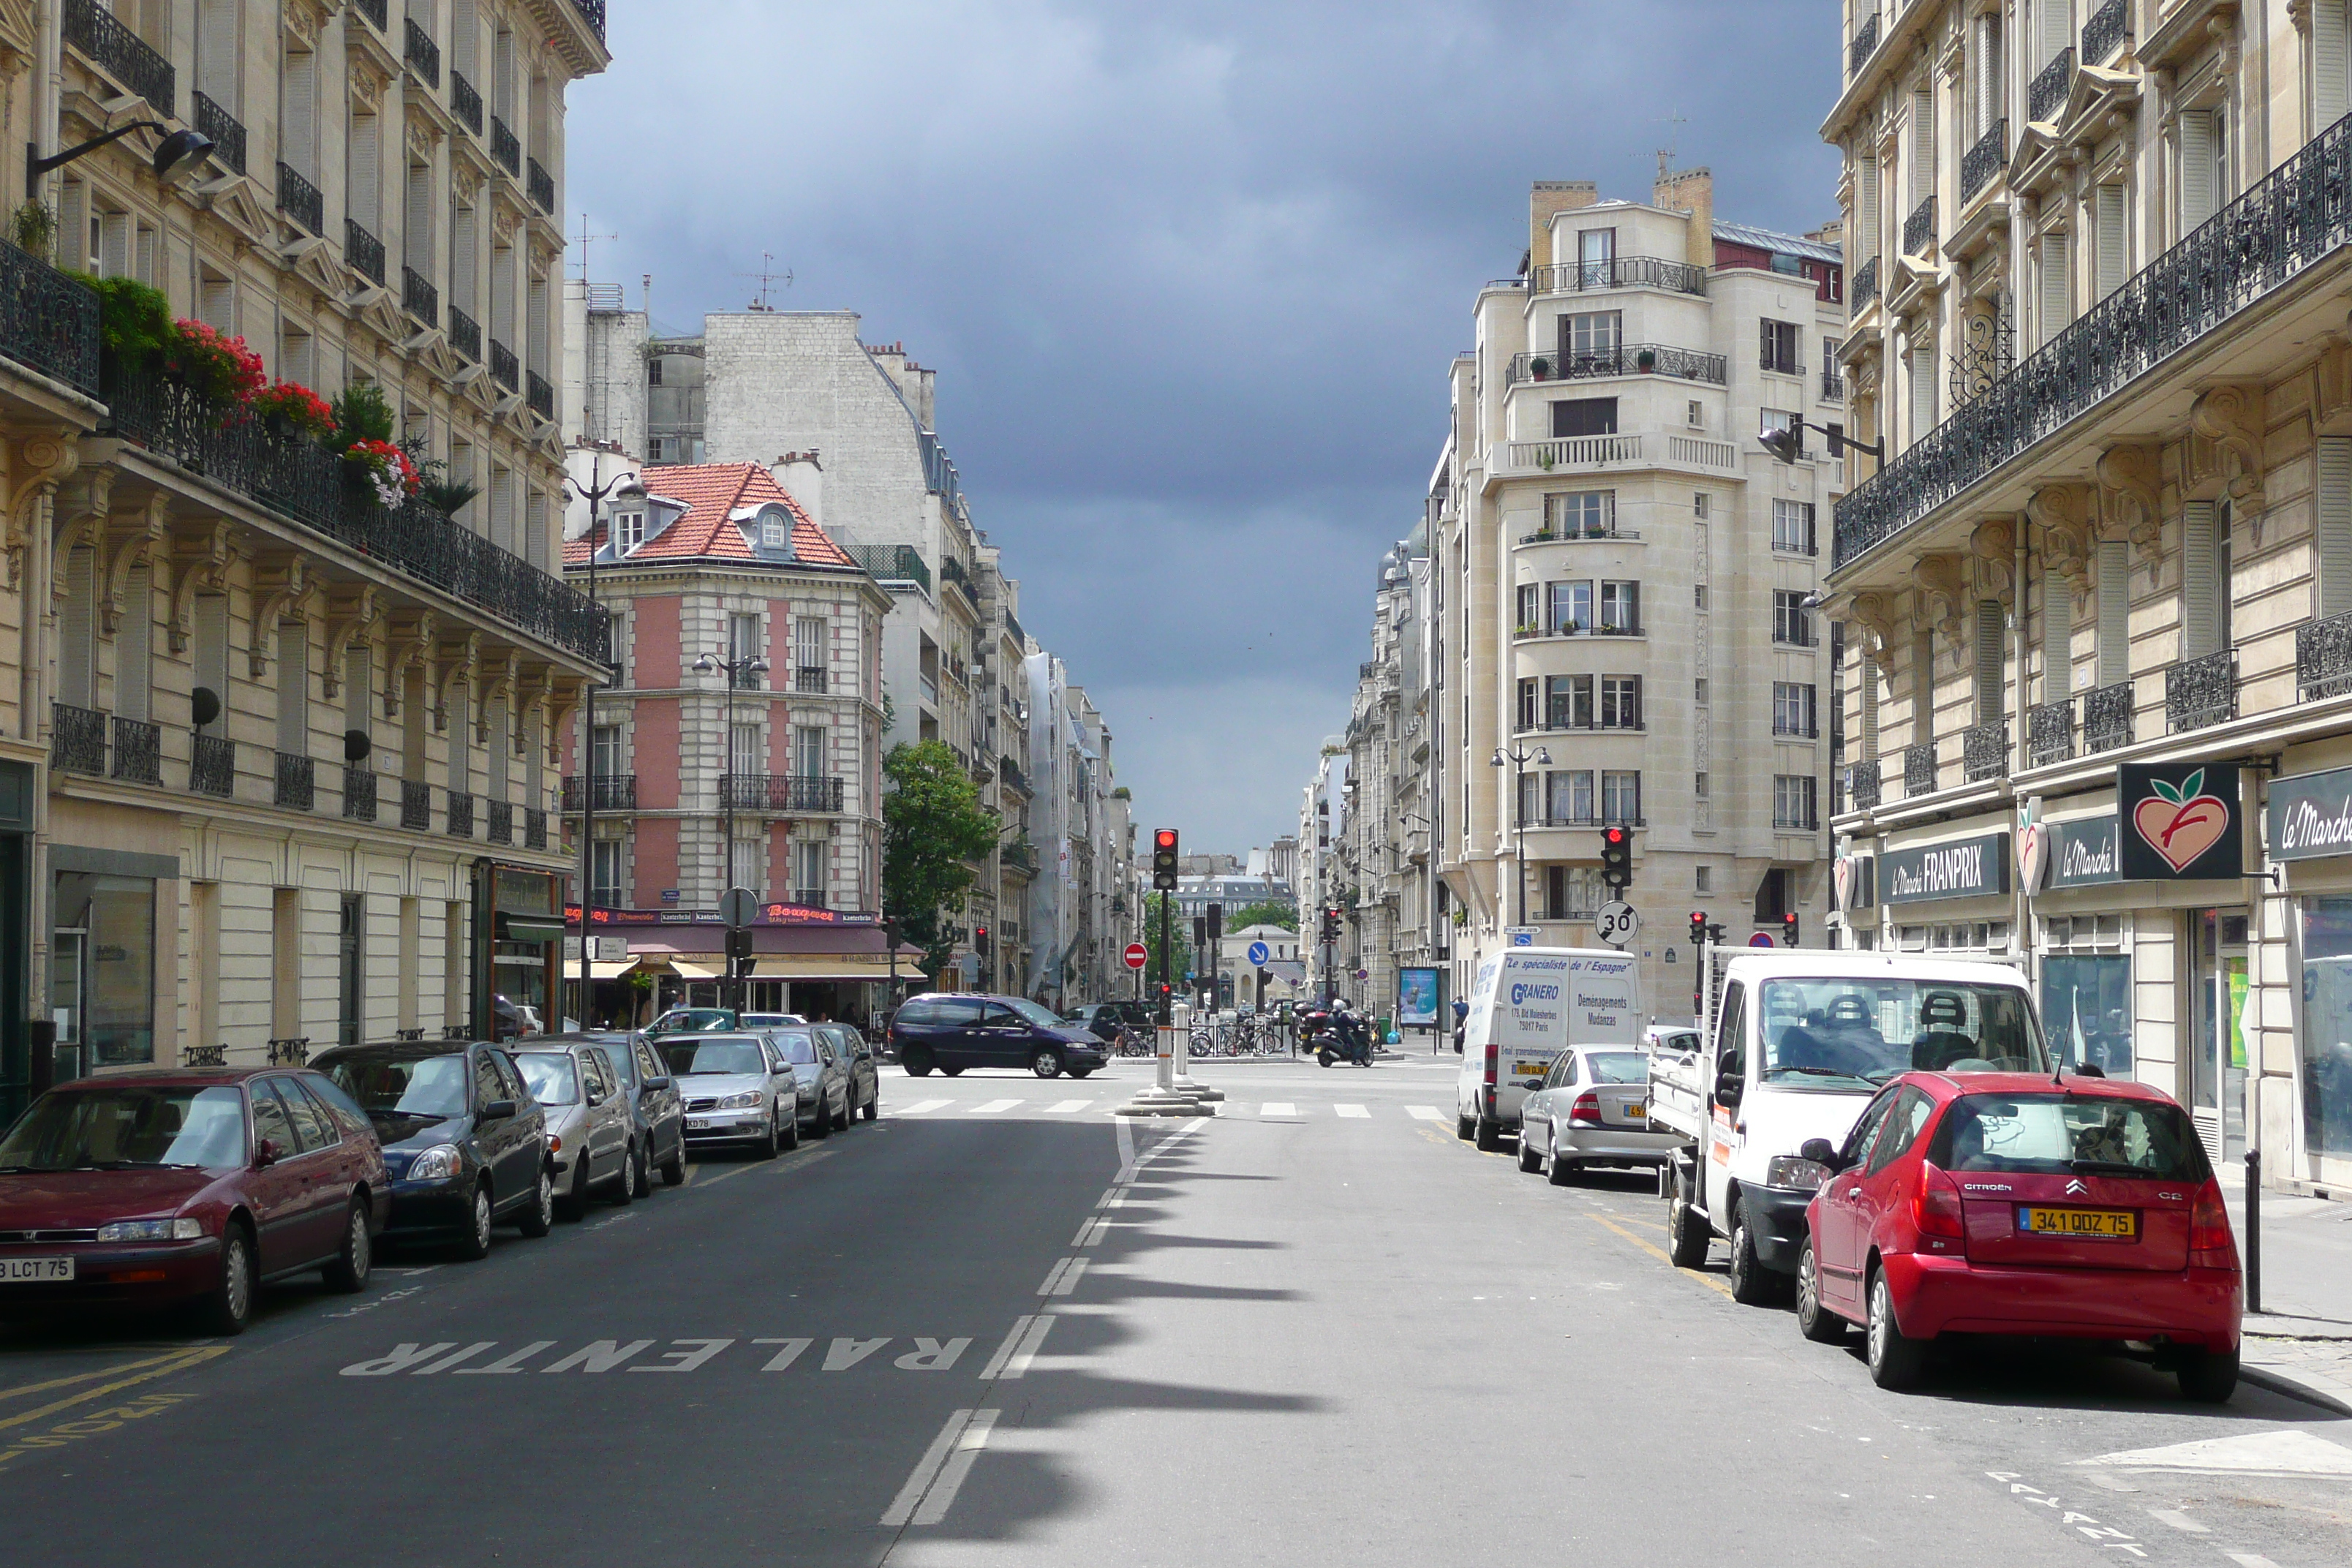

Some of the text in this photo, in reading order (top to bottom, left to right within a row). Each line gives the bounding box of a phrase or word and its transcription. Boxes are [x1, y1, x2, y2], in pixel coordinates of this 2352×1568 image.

[2072, 836, 2111, 876] Marché
[1898, 863, 1923, 895] Marché
[1923, 844, 1982, 892] FRANPRIX
[767, 905, 834, 921] Bouquet
[1604, 914, 1630, 931] 30
[1522, 958, 1567, 971] spécialiste
[1570, 960, 1581, 970] de
[1511, 983, 1559, 1005] GRANERO
[1578, 993, 1627, 1011] Déménagements
[1536, 1021, 1548, 1032] Paris
[1588, 1011, 1616, 1026] Mudanzas
[699, 1120, 709, 1128] 78
[1964, 1183, 2012, 1192] CITROËN
[2158, 1191, 2183, 1201] C2
[2036, 1211, 2067, 1231] 341
[2071, 1213, 2103, 1232] QDZ
[2108, 1214, 2129, 1233] 75
[12, 1262, 42, 1278] LCT
[48, 1260, 69, 1277] 75
[339, 1337, 974, 1377] RALENTIR
[1984, 1471, 2149, 1558] PAYANT
